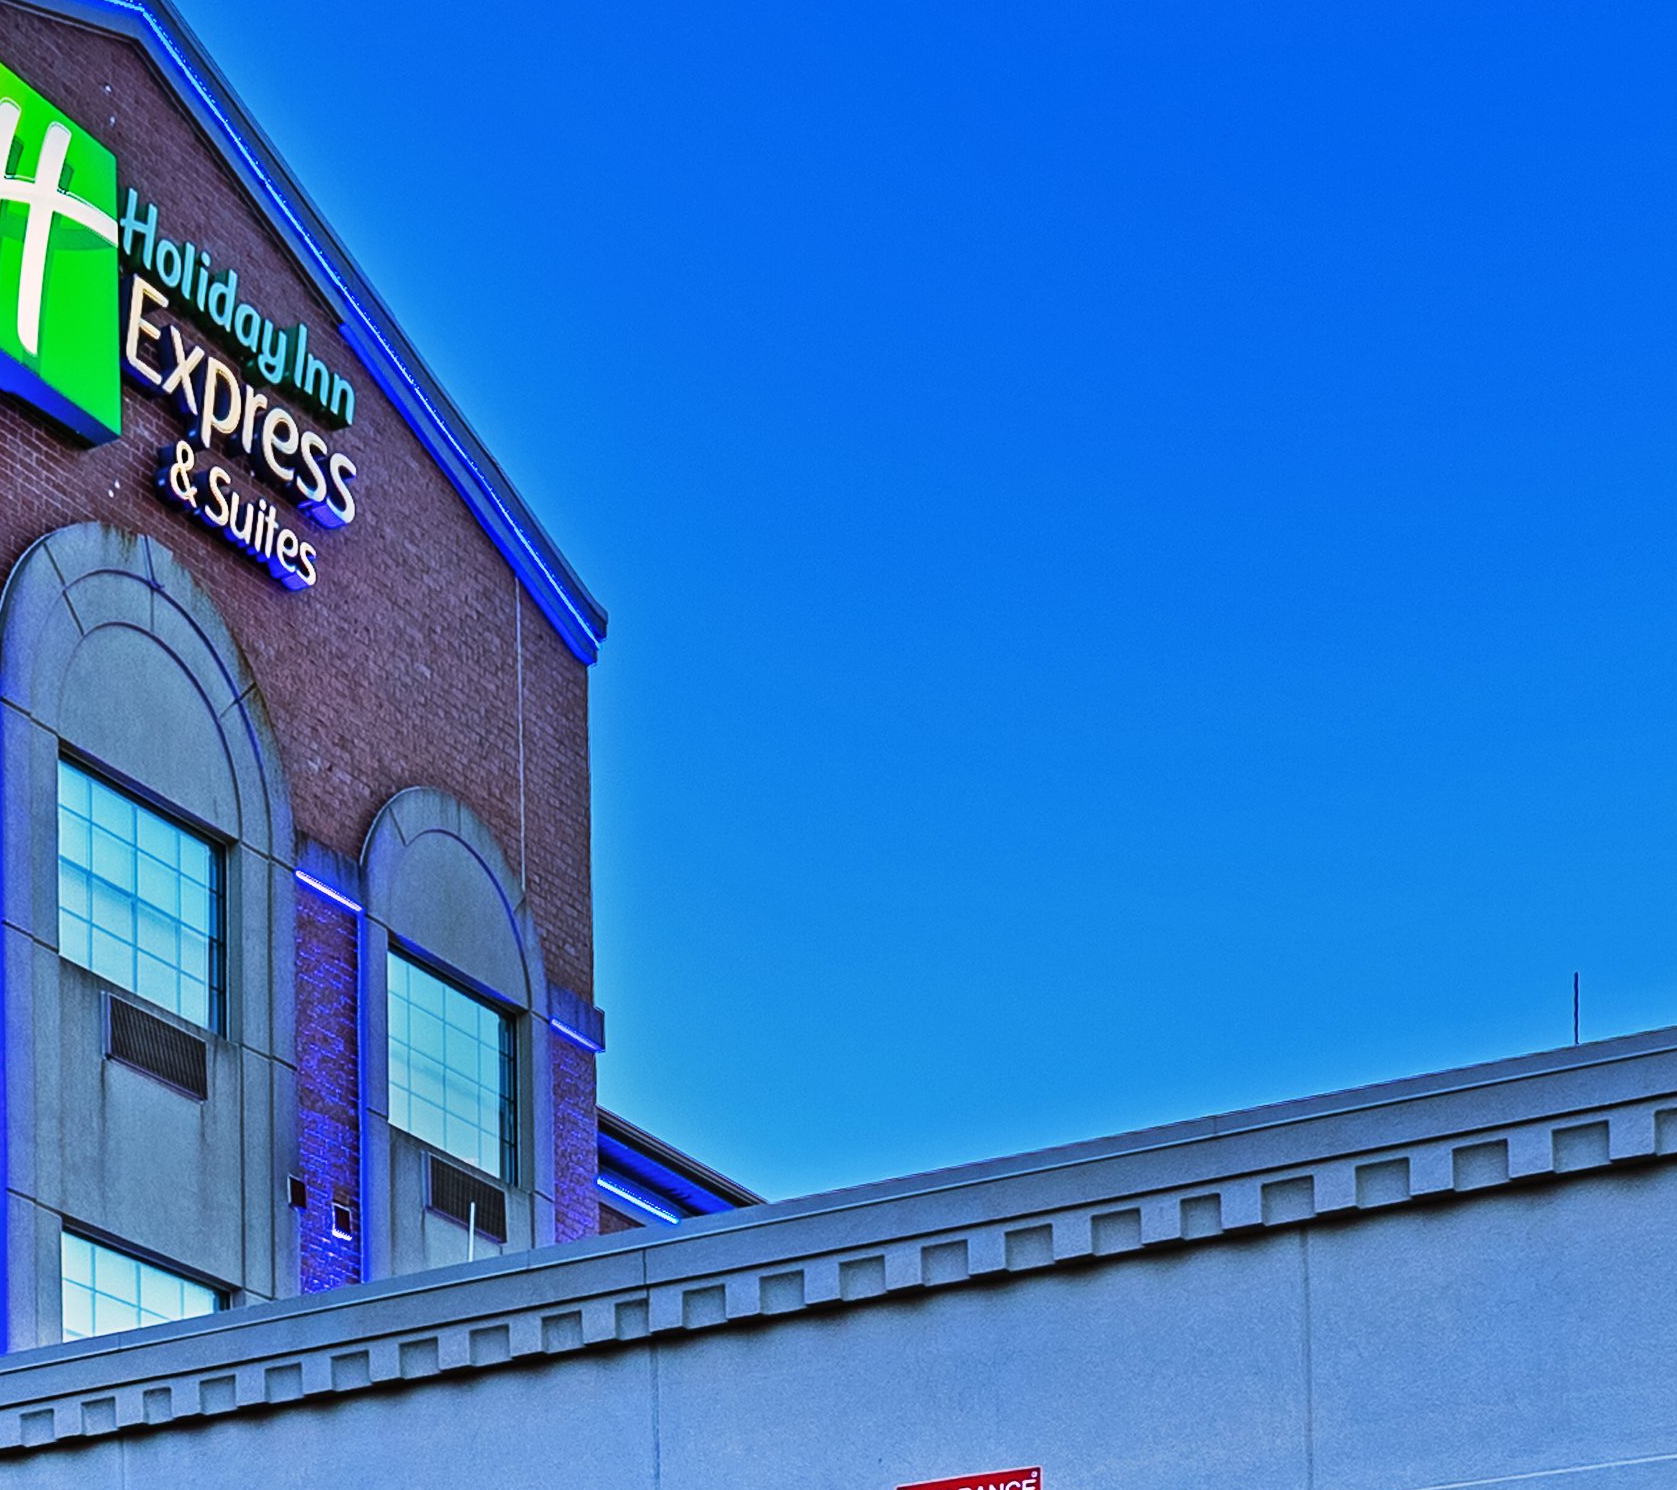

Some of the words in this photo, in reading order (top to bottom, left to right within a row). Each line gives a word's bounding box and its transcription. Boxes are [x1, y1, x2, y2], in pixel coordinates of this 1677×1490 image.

[120, 187, 286, 384] Holiday
[296, 323, 356, 426] Inn
[125, 274, 357, 524] Express
[169, 440, 197, 508] &
[205, 466, 317, 586] Suites
